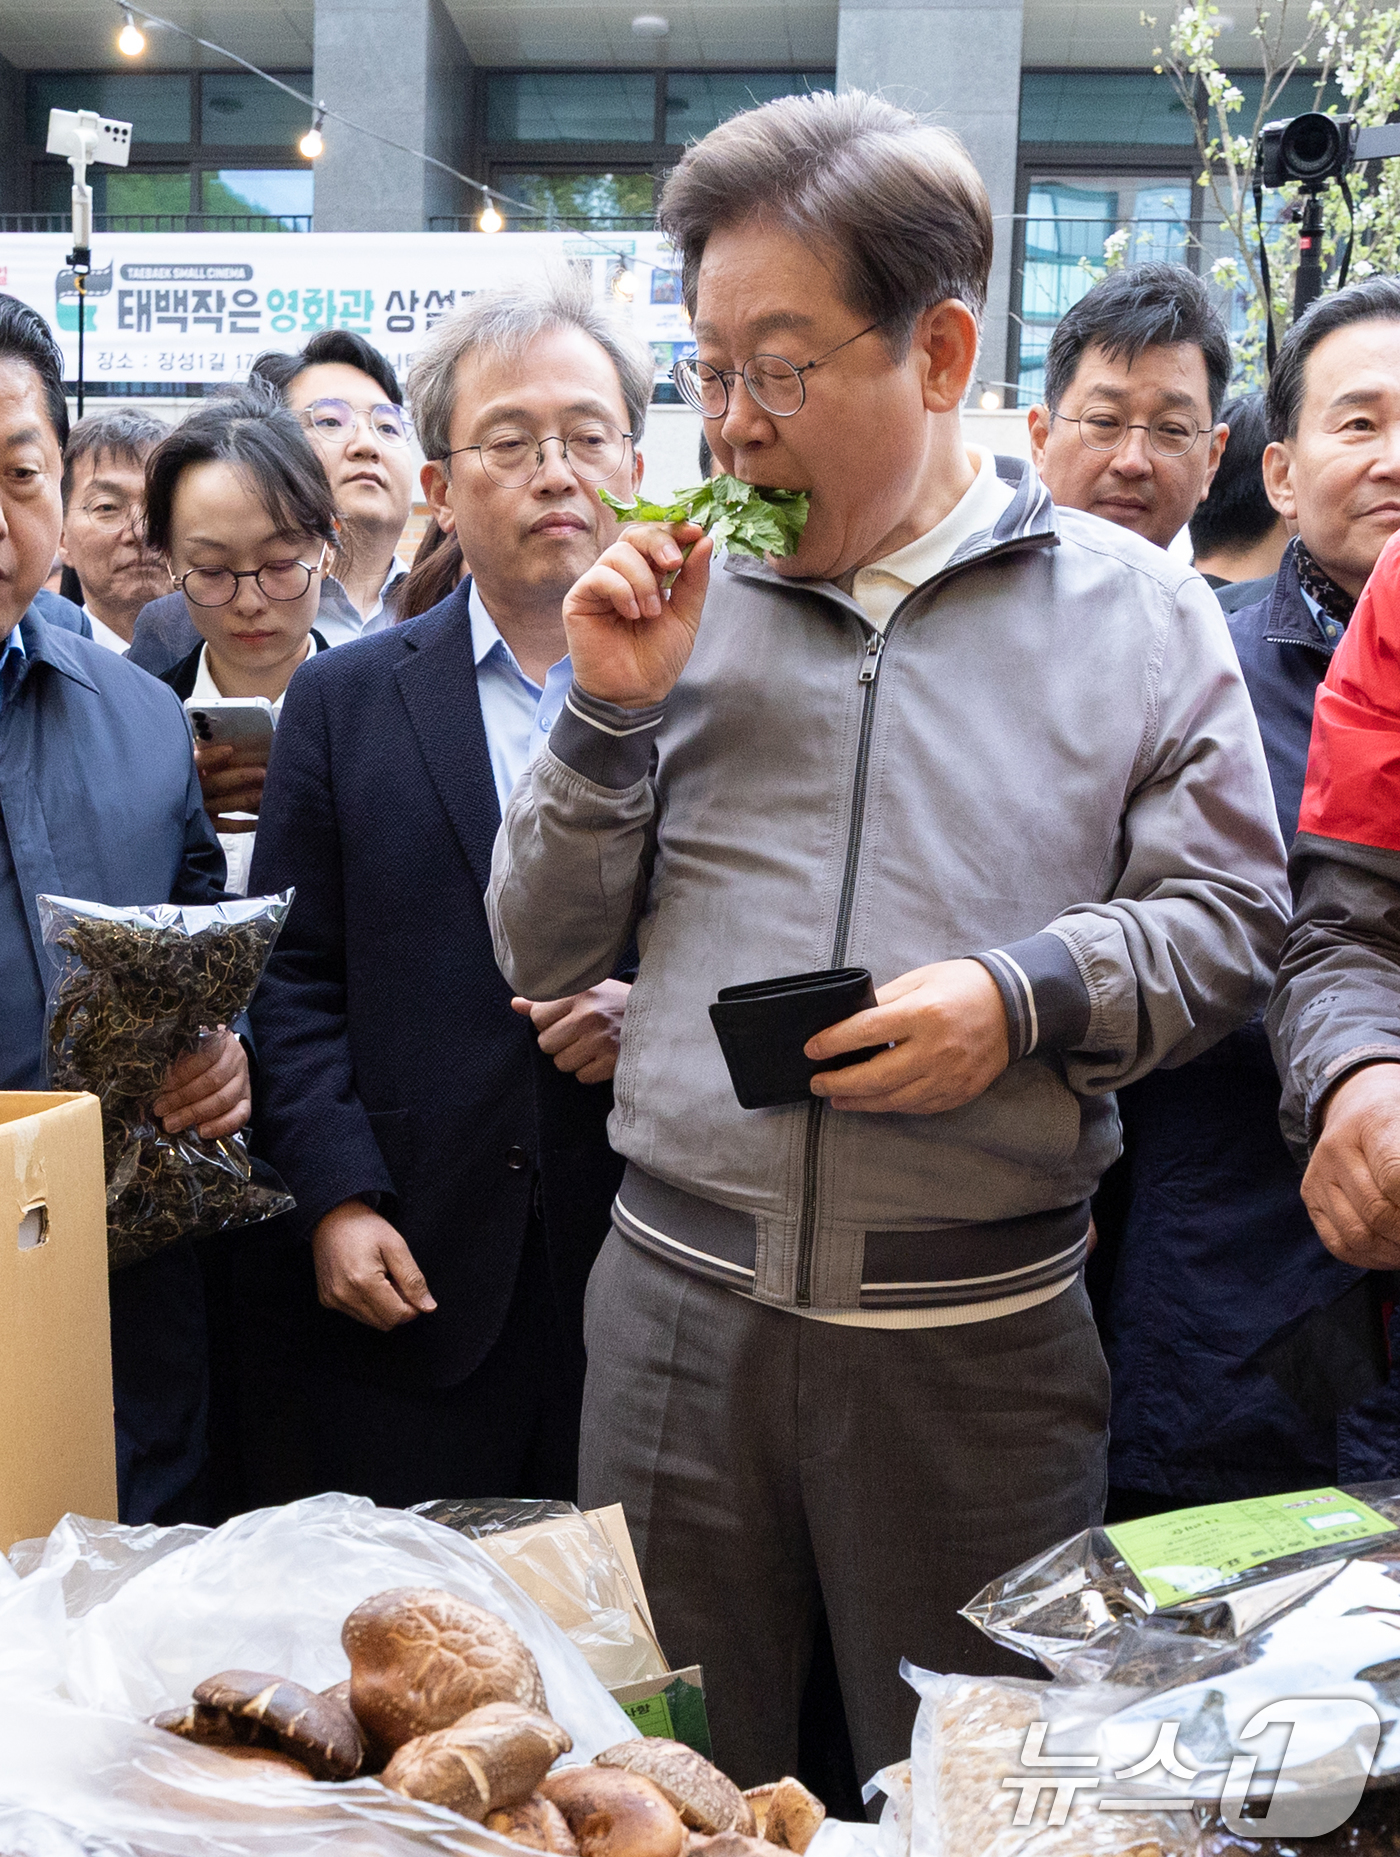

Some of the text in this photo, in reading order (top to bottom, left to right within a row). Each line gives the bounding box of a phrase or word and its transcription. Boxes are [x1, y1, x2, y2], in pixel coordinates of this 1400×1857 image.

[127, 267, 246, 280] TAEBAEK SMALL CINEMA
[98, 352, 133, 371] 장소
[158, 352, 225, 371] 장성1길
